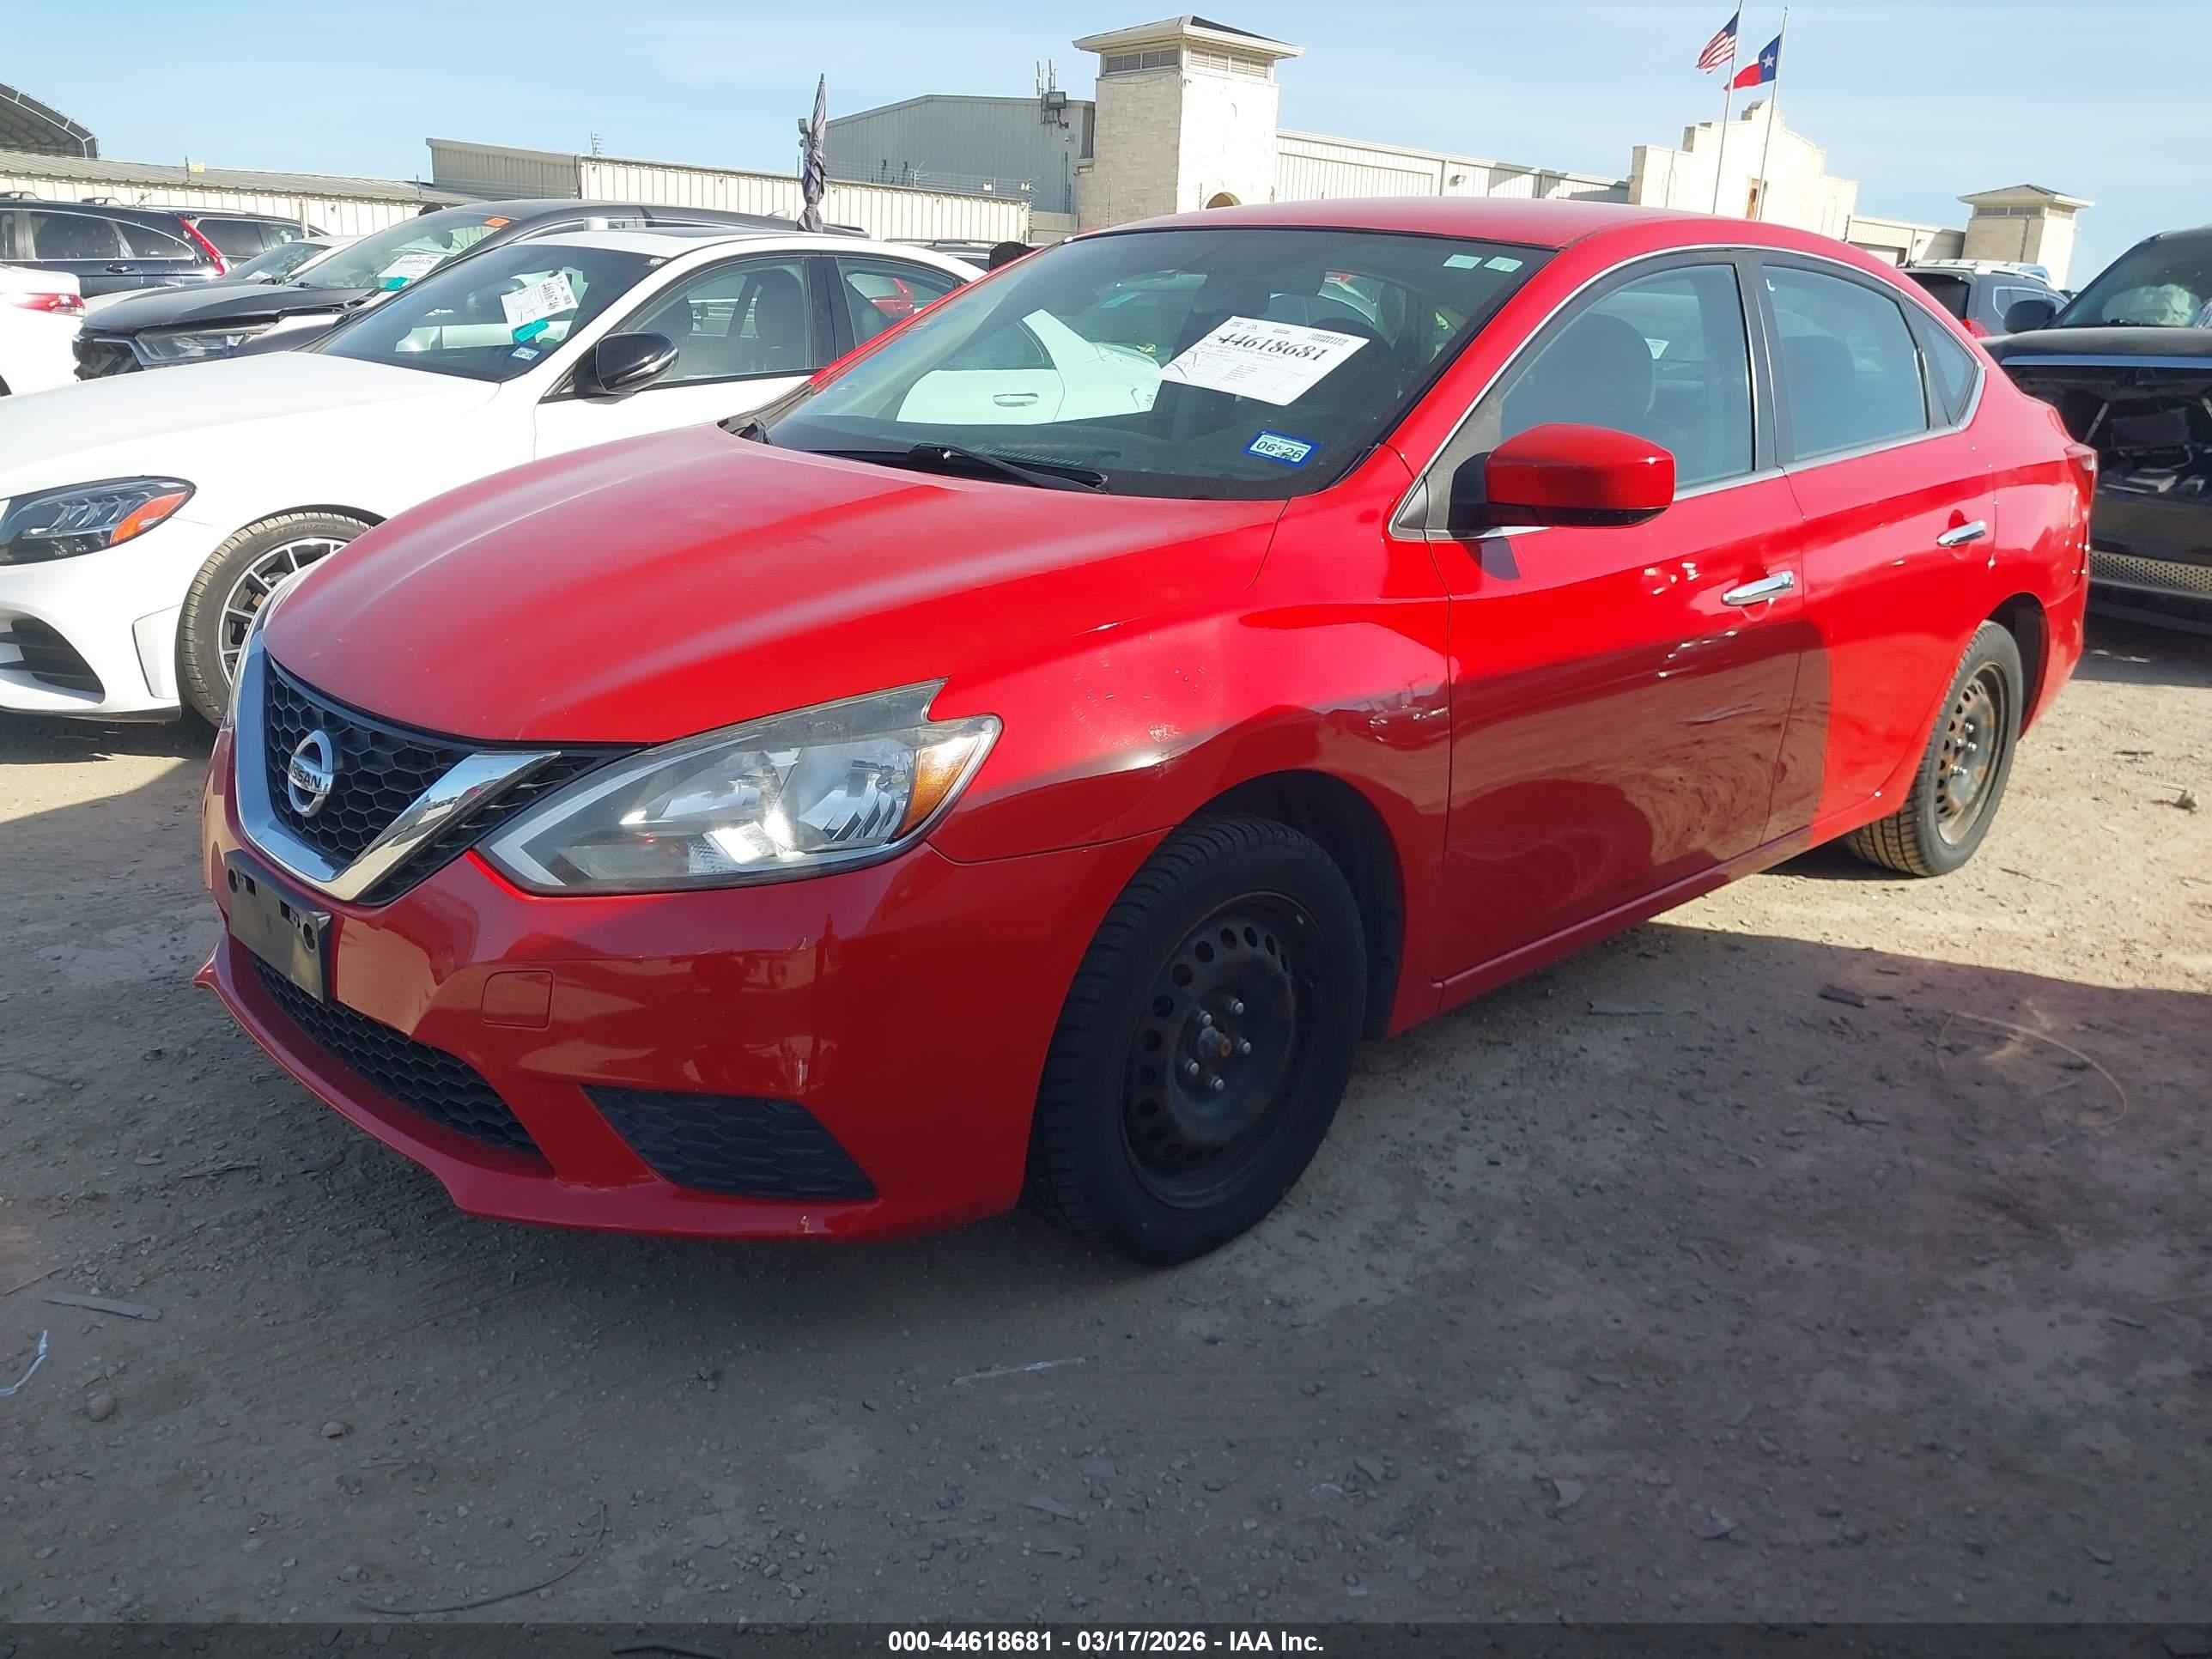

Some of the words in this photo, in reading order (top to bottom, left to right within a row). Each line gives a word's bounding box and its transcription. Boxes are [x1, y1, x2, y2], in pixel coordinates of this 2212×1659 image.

[1218, 333, 1328, 362] 44618681
[1256, 441, 1278, 453] 06
[1282, 447, 1304, 459] 26
